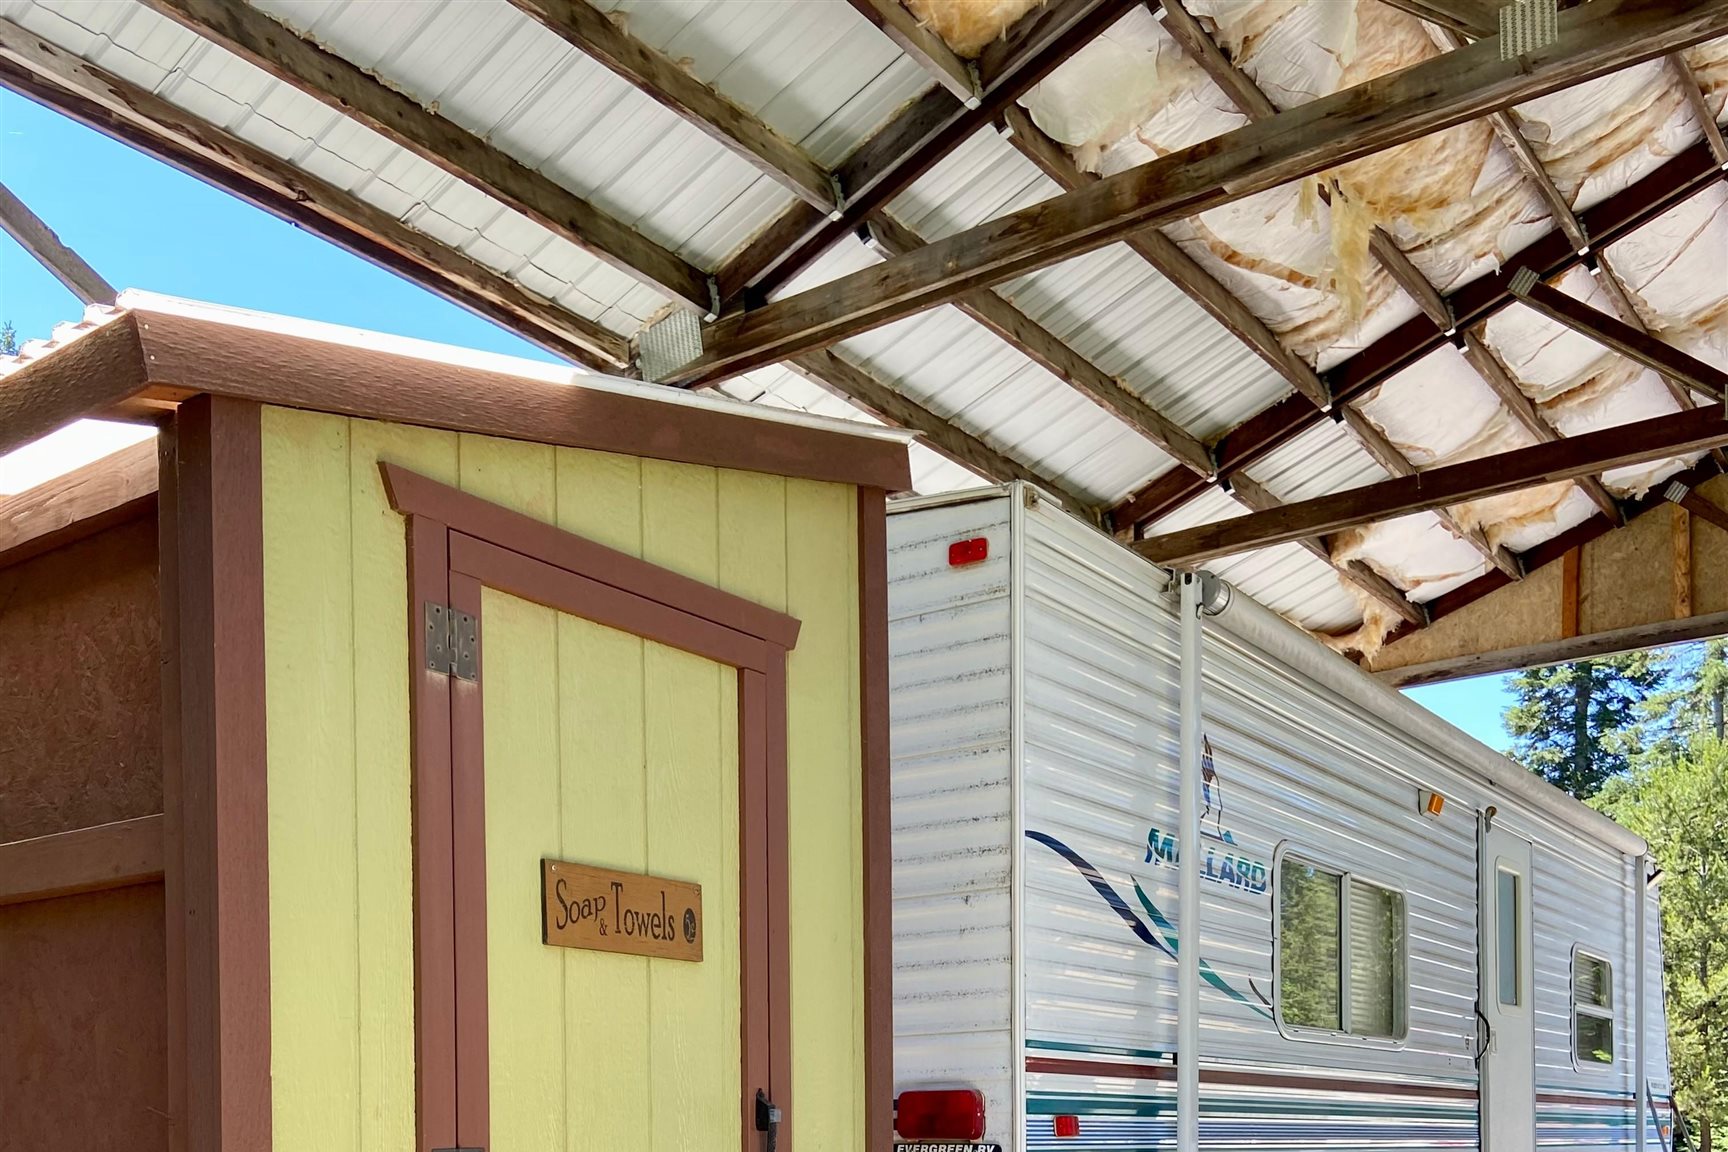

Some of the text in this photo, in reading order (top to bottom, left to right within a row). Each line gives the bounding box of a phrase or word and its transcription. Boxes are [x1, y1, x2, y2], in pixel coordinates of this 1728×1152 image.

[1144, 827, 1267, 895] MLARD
[555, 878, 607, 931] Soap
[599, 917, 608, 937] &
[610, 881, 676, 941] Towels
